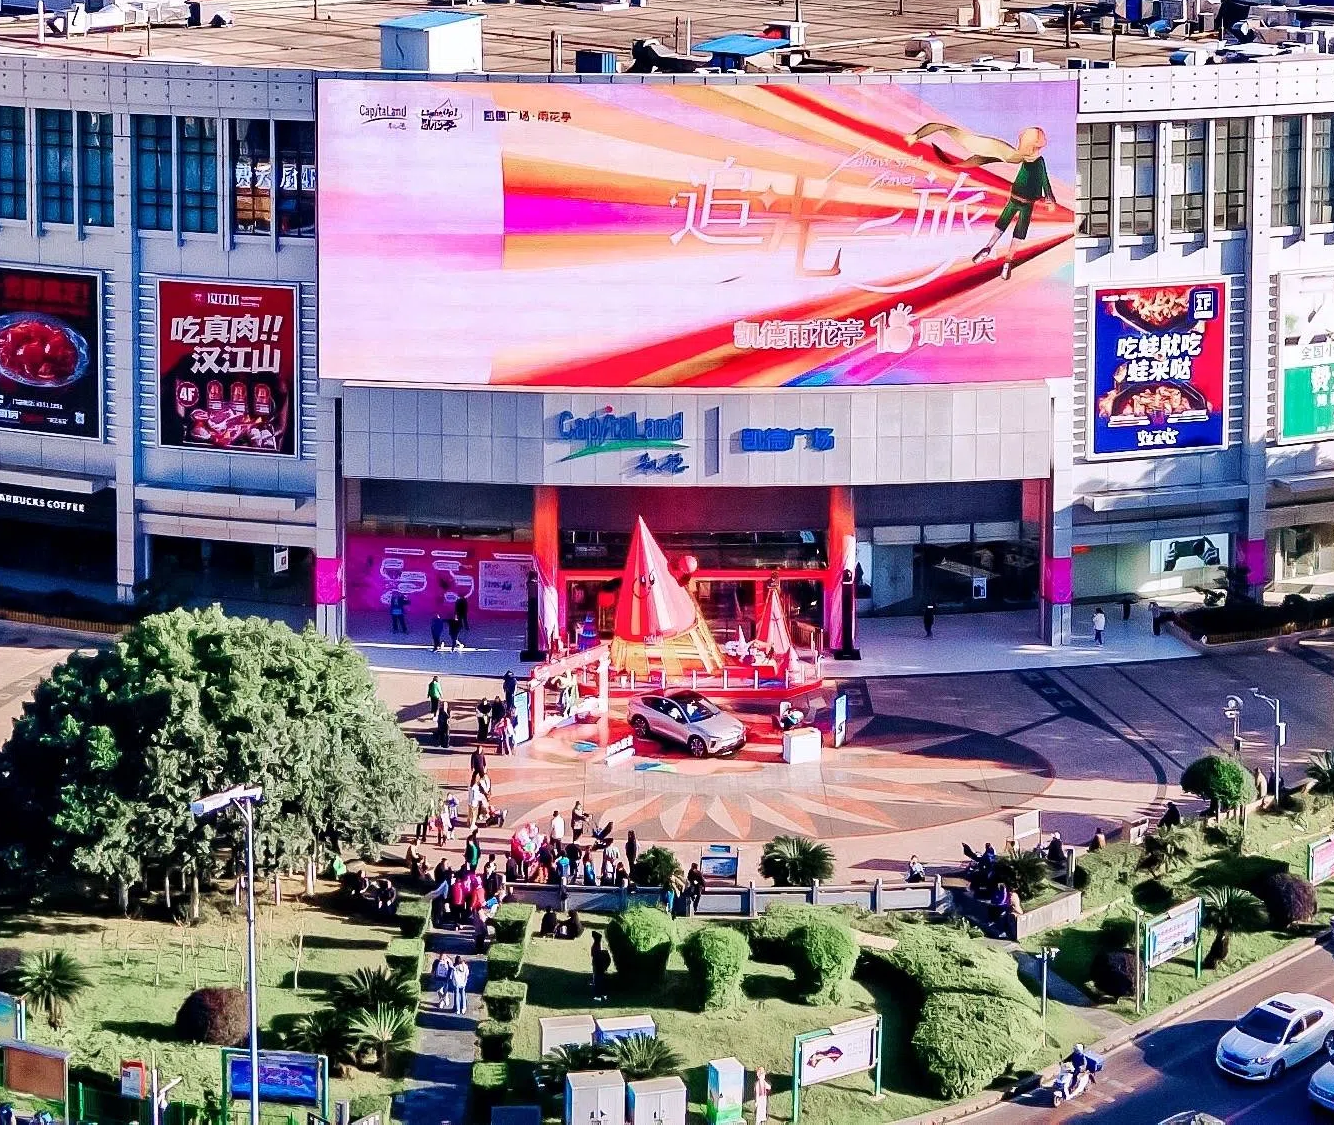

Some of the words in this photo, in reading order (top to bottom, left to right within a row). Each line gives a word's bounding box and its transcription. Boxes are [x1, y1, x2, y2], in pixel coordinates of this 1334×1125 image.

[359, 104, 407, 118] CapitaLand
[670, 156, 991, 293] 追光之旅
[190, 344, 281, 374] 汉江山
[1117, 332, 1202, 360] 吃蛙就吃
[1126, 355, 1192, 382] 蛙来哒
[179, 387, 196, 402] 4F
[558, 404, 684, 446] CapitaLand
[46, 500, 85, 513] COFFEE
